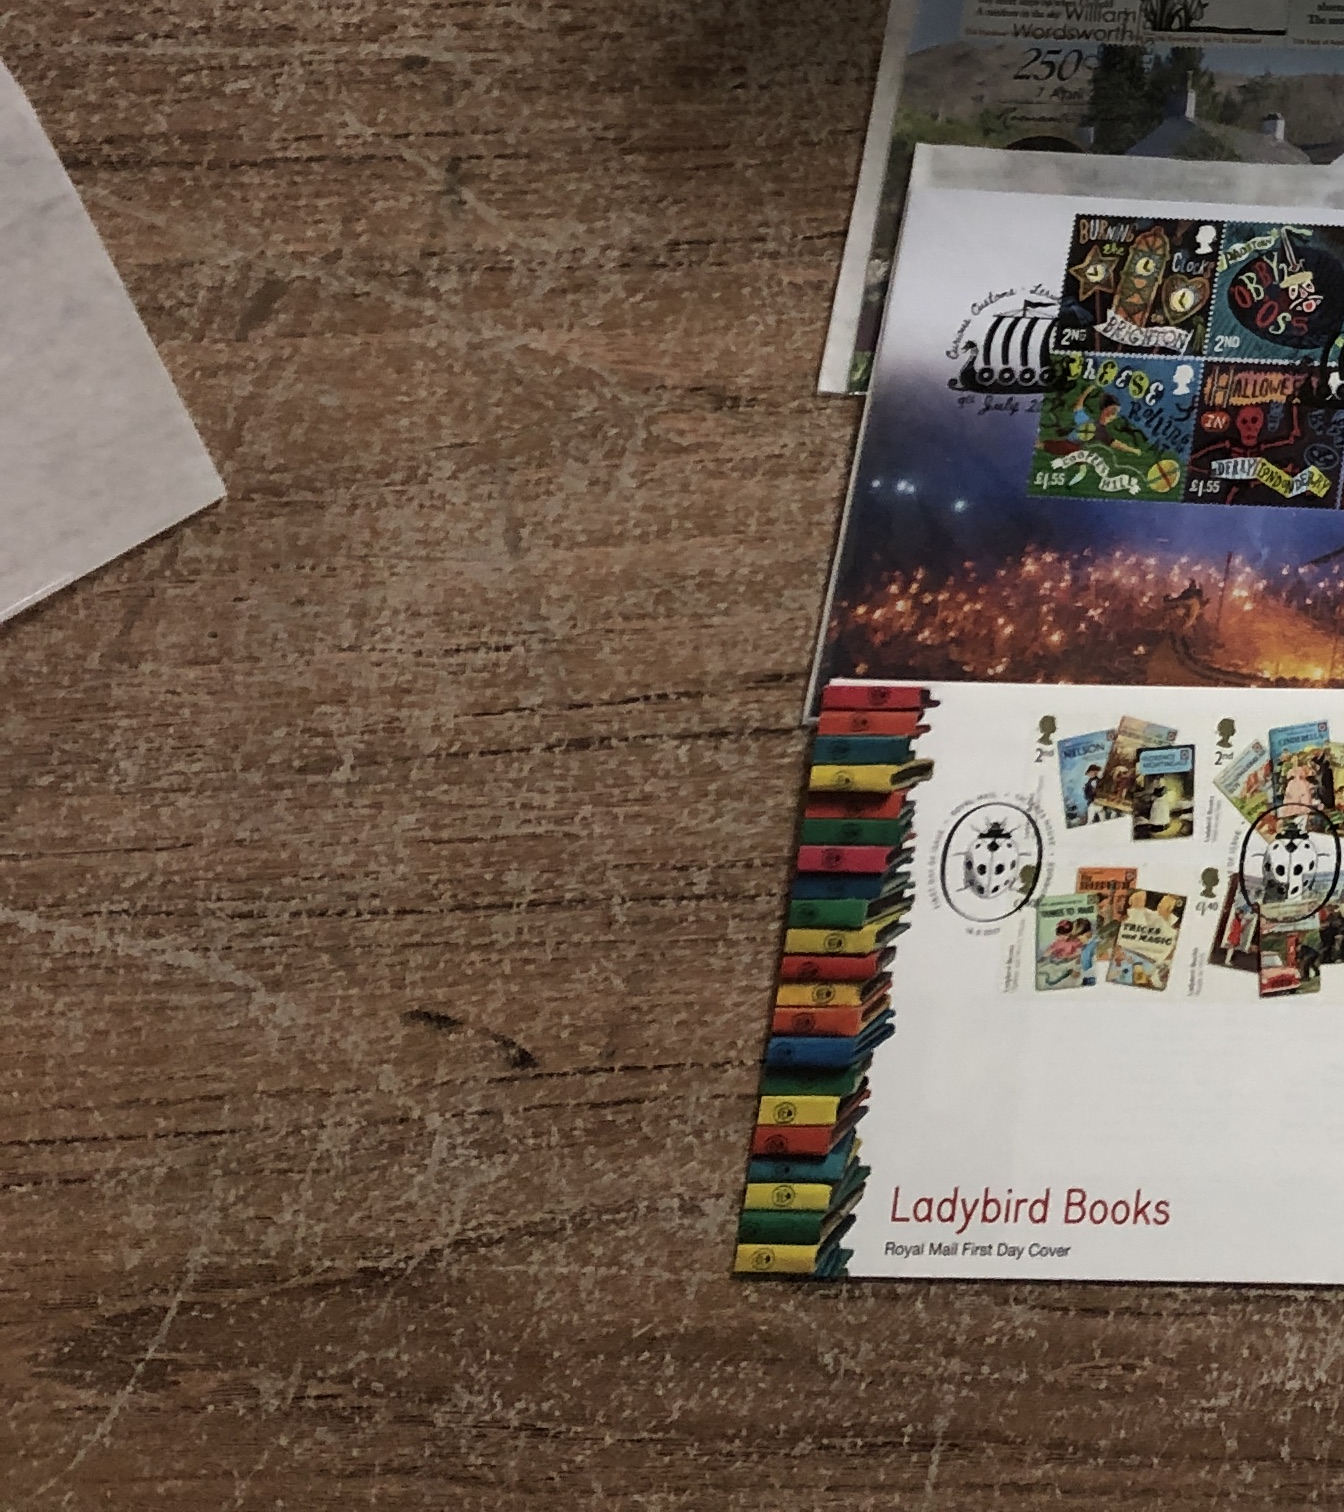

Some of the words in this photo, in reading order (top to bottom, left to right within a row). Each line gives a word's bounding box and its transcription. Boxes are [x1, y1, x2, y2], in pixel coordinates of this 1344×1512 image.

[1065, 4, 1136, 24] William
[1012, 22, 1136, 42] Wordsworth
[1013, 47, 1084, 82] 250
[1079, 219, 1138, 245] BURNING
[1103, 315, 1189, 351] BRIGHTON
[1214, 336, 1241, 354] 2ND
[1033, 472, 1066, 490] £1.55
[1189, 480, 1221, 497] £1.55
[1063, 742, 1106, 759] NELSON
[1214, 750, 1234, 766] 2nd
[1122, 922, 1161, 936] TRICKS
[890, 1185, 1051, 1235] Ladybird
[1063, 1187, 1170, 1226] Books
[884, 1241, 925, 1259] Royal
[928, 1242, 958, 1257] Mail
[961, 1242, 993, 1257] First
[996, 1242, 1025, 1260] Day
[1027, 1242, 1072, 1258] Cover
